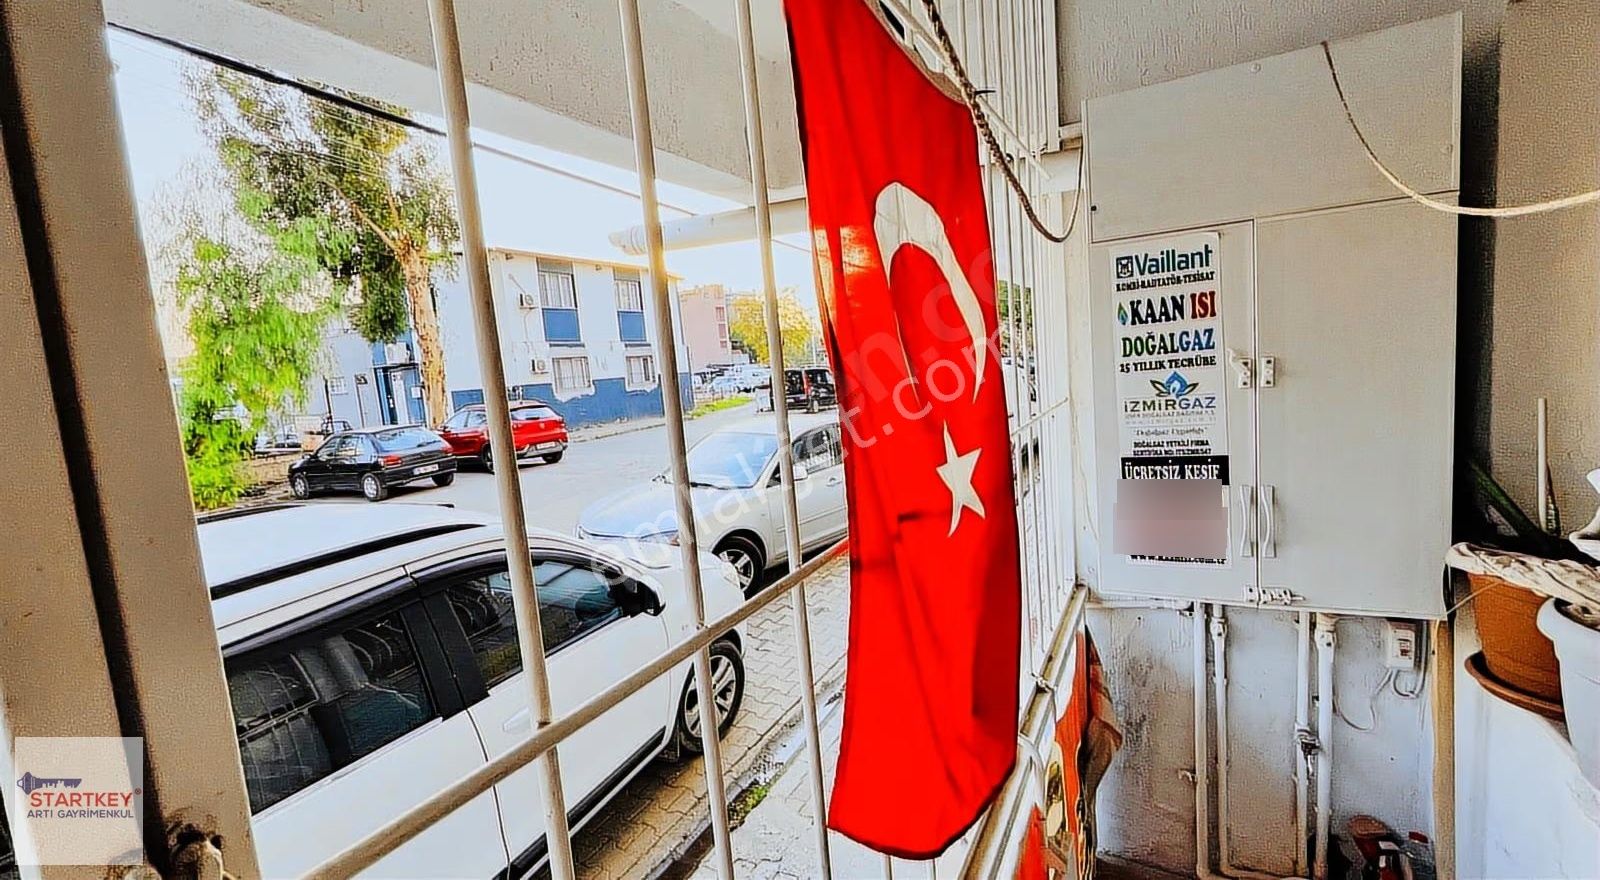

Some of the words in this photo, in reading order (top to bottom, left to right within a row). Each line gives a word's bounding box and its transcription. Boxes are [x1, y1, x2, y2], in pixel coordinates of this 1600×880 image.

[1135, 244, 1213, 276] Vaillant
[1130, 294, 1185, 326] KAAN
[1190, 290, 1217, 320] ISI
[1122, 328, 1216, 358] DOĞALGAZ
[1133, 358, 1167, 372] YILLIK
[1168, 354, 1217, 369] TECRÜBE
[1124, 459, 1181, 479] ÜCRETSİZ
